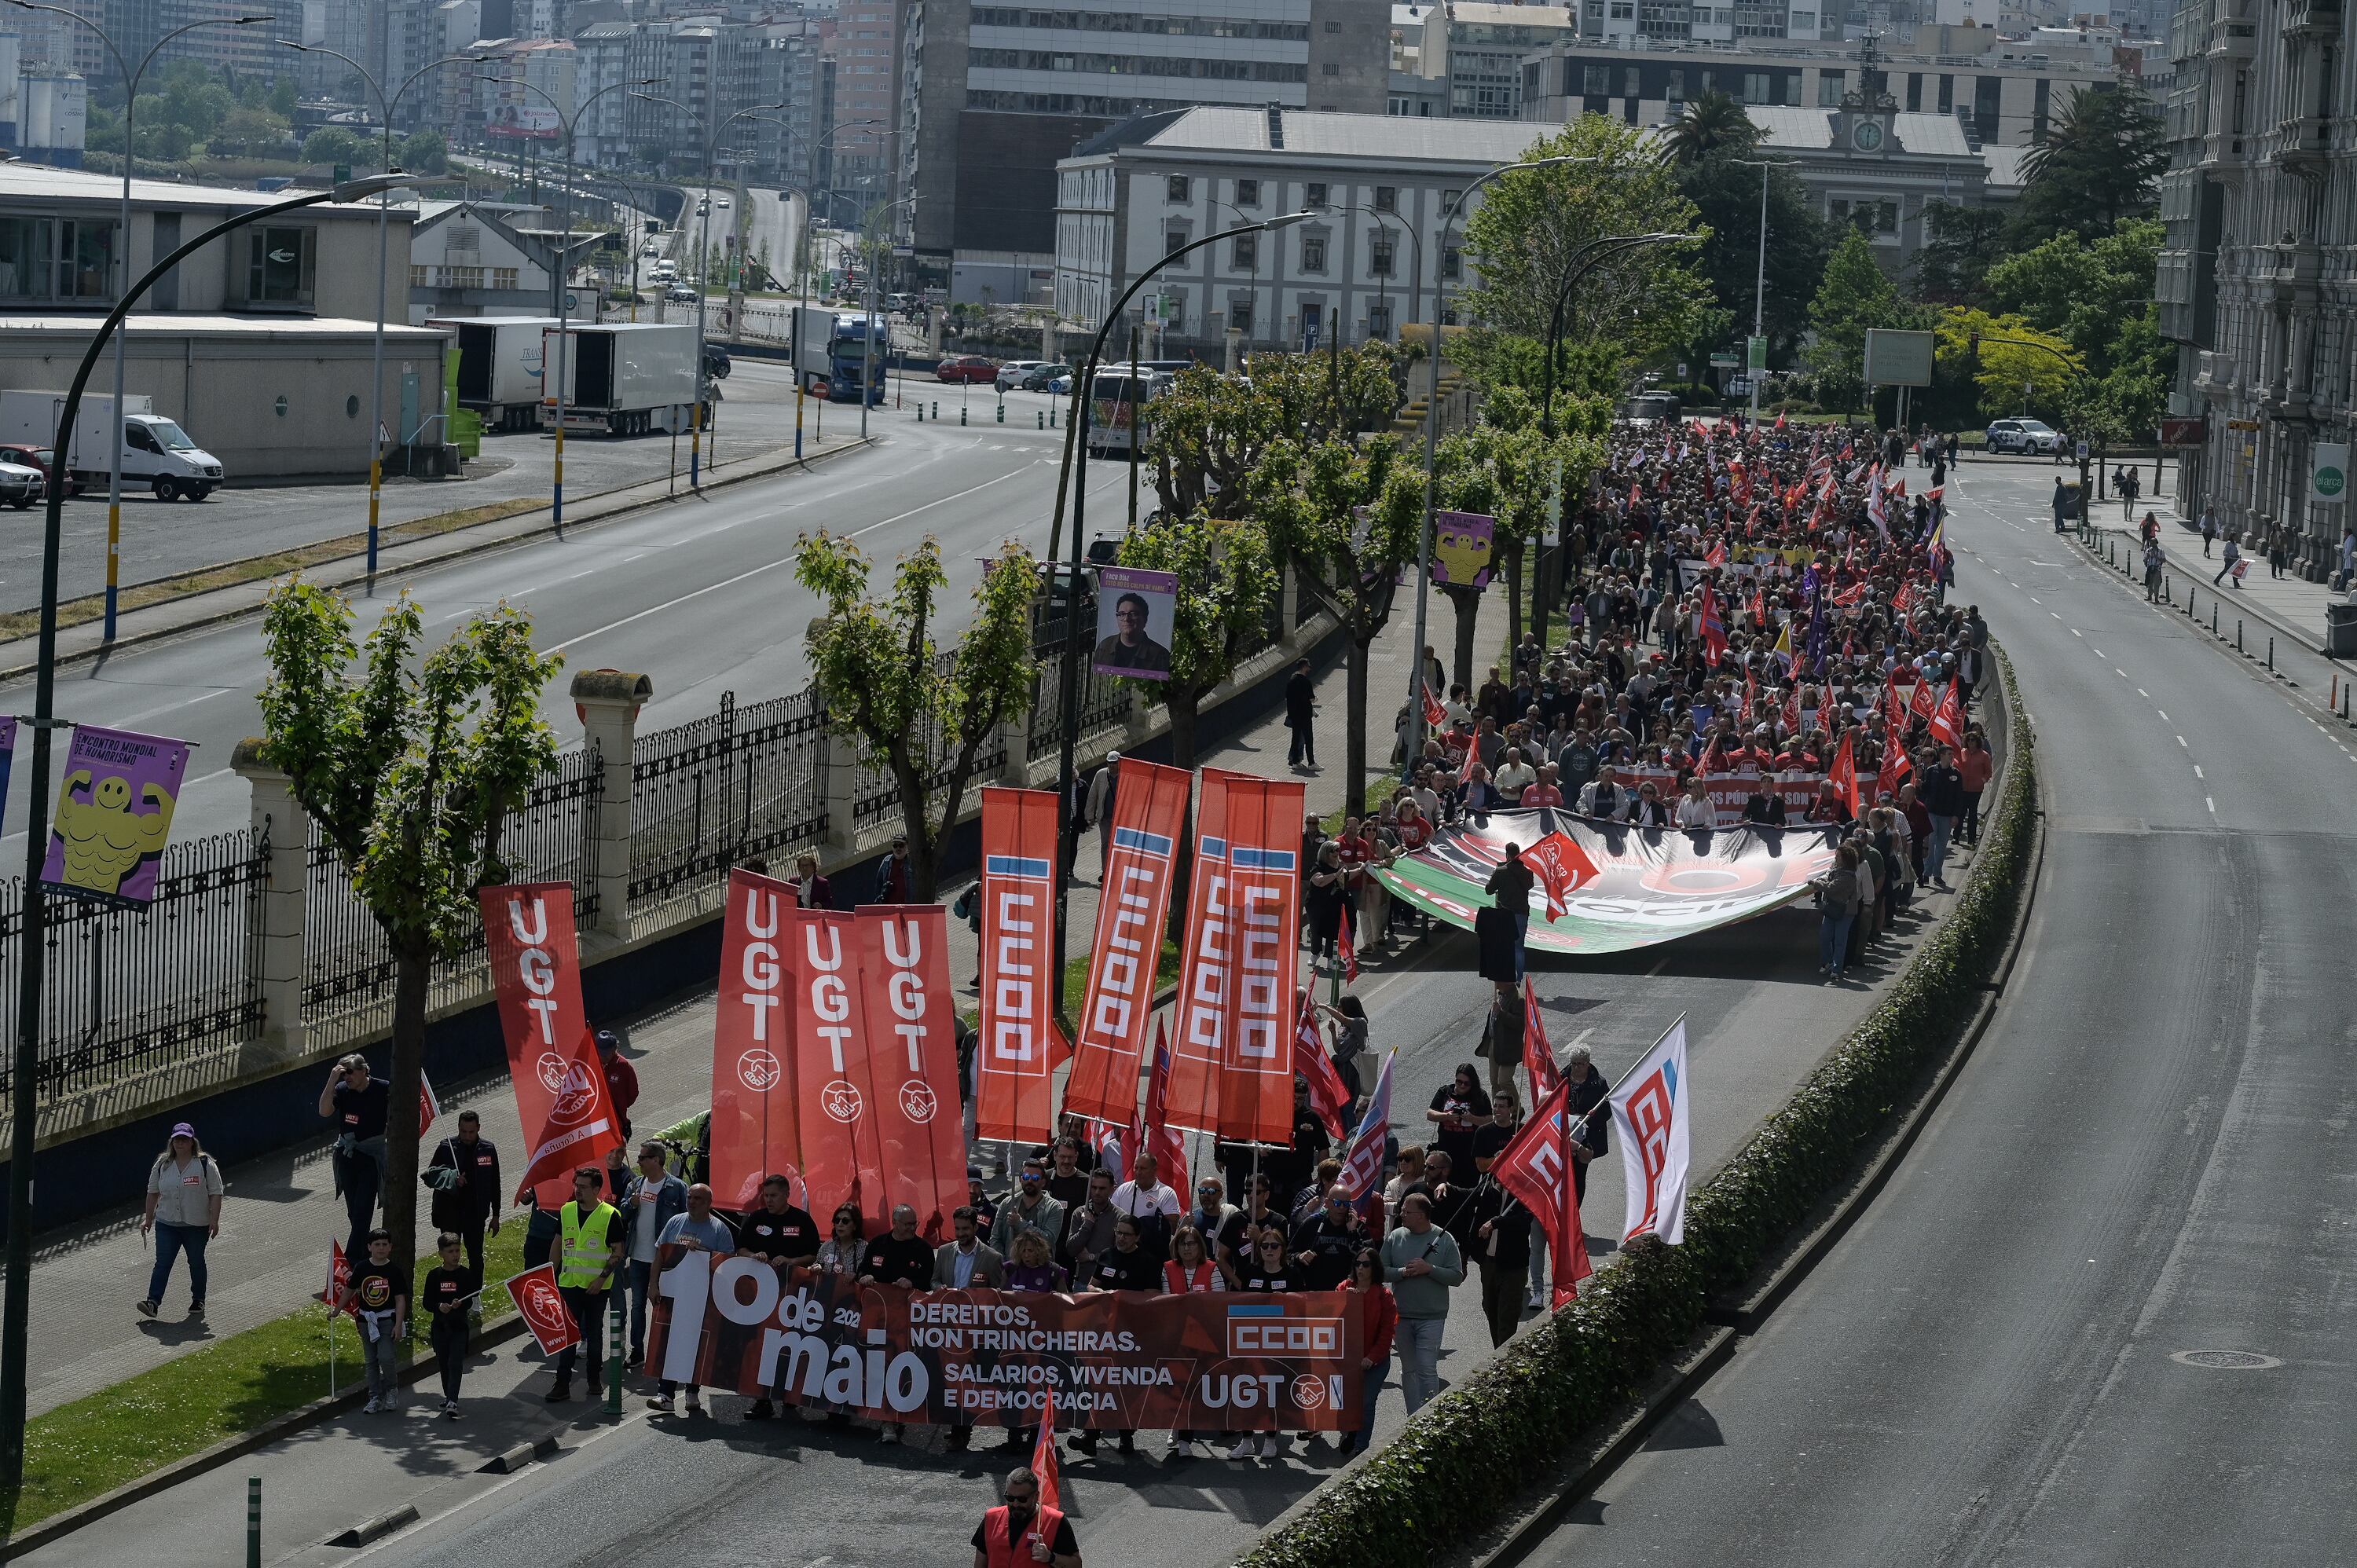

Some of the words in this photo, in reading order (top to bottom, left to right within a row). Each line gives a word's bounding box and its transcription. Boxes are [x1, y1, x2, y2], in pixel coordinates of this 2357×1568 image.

[74, 743, 80, 755] DE
[84, 746, 137, 765] HUMORISMO
[77, 733, 120, 751] ENCONTRO
[122, 743, 158, 758] MUNDIAL
[508, 899, 557, 1045] UGT
[742, 888, 779, 1040] UGT
[1094, 865, 1154, 1038] CCOO
[1240, 885, 1280, 1058] CCOO
[806, 925, 852, 1072] UGT
[882, 920, 927, 1072] UGT
[995, 892, 1034, 1061] CCOO
[778, 1287, 824, 1332] de
[911, 1302, 1037, 1329] DEREITOS,
[911, 1327, 962, 1349] NON
[967, 1329, 1142, 1352] TRINCHEIRAS.
[1236, 1326, 1336, 1350] CCOO
[757, 1329, 929, 1412] maio
[944, 1363, 1065, 1387] SALARIOS,
[1069, 1366, 1174, 1386] VIVENDA
[1201, 1374, 1285, 1409] UGT
[944, 1388, 958, 1408] E
[963, 1390, 1118, 1411] DEMOCRACIA
